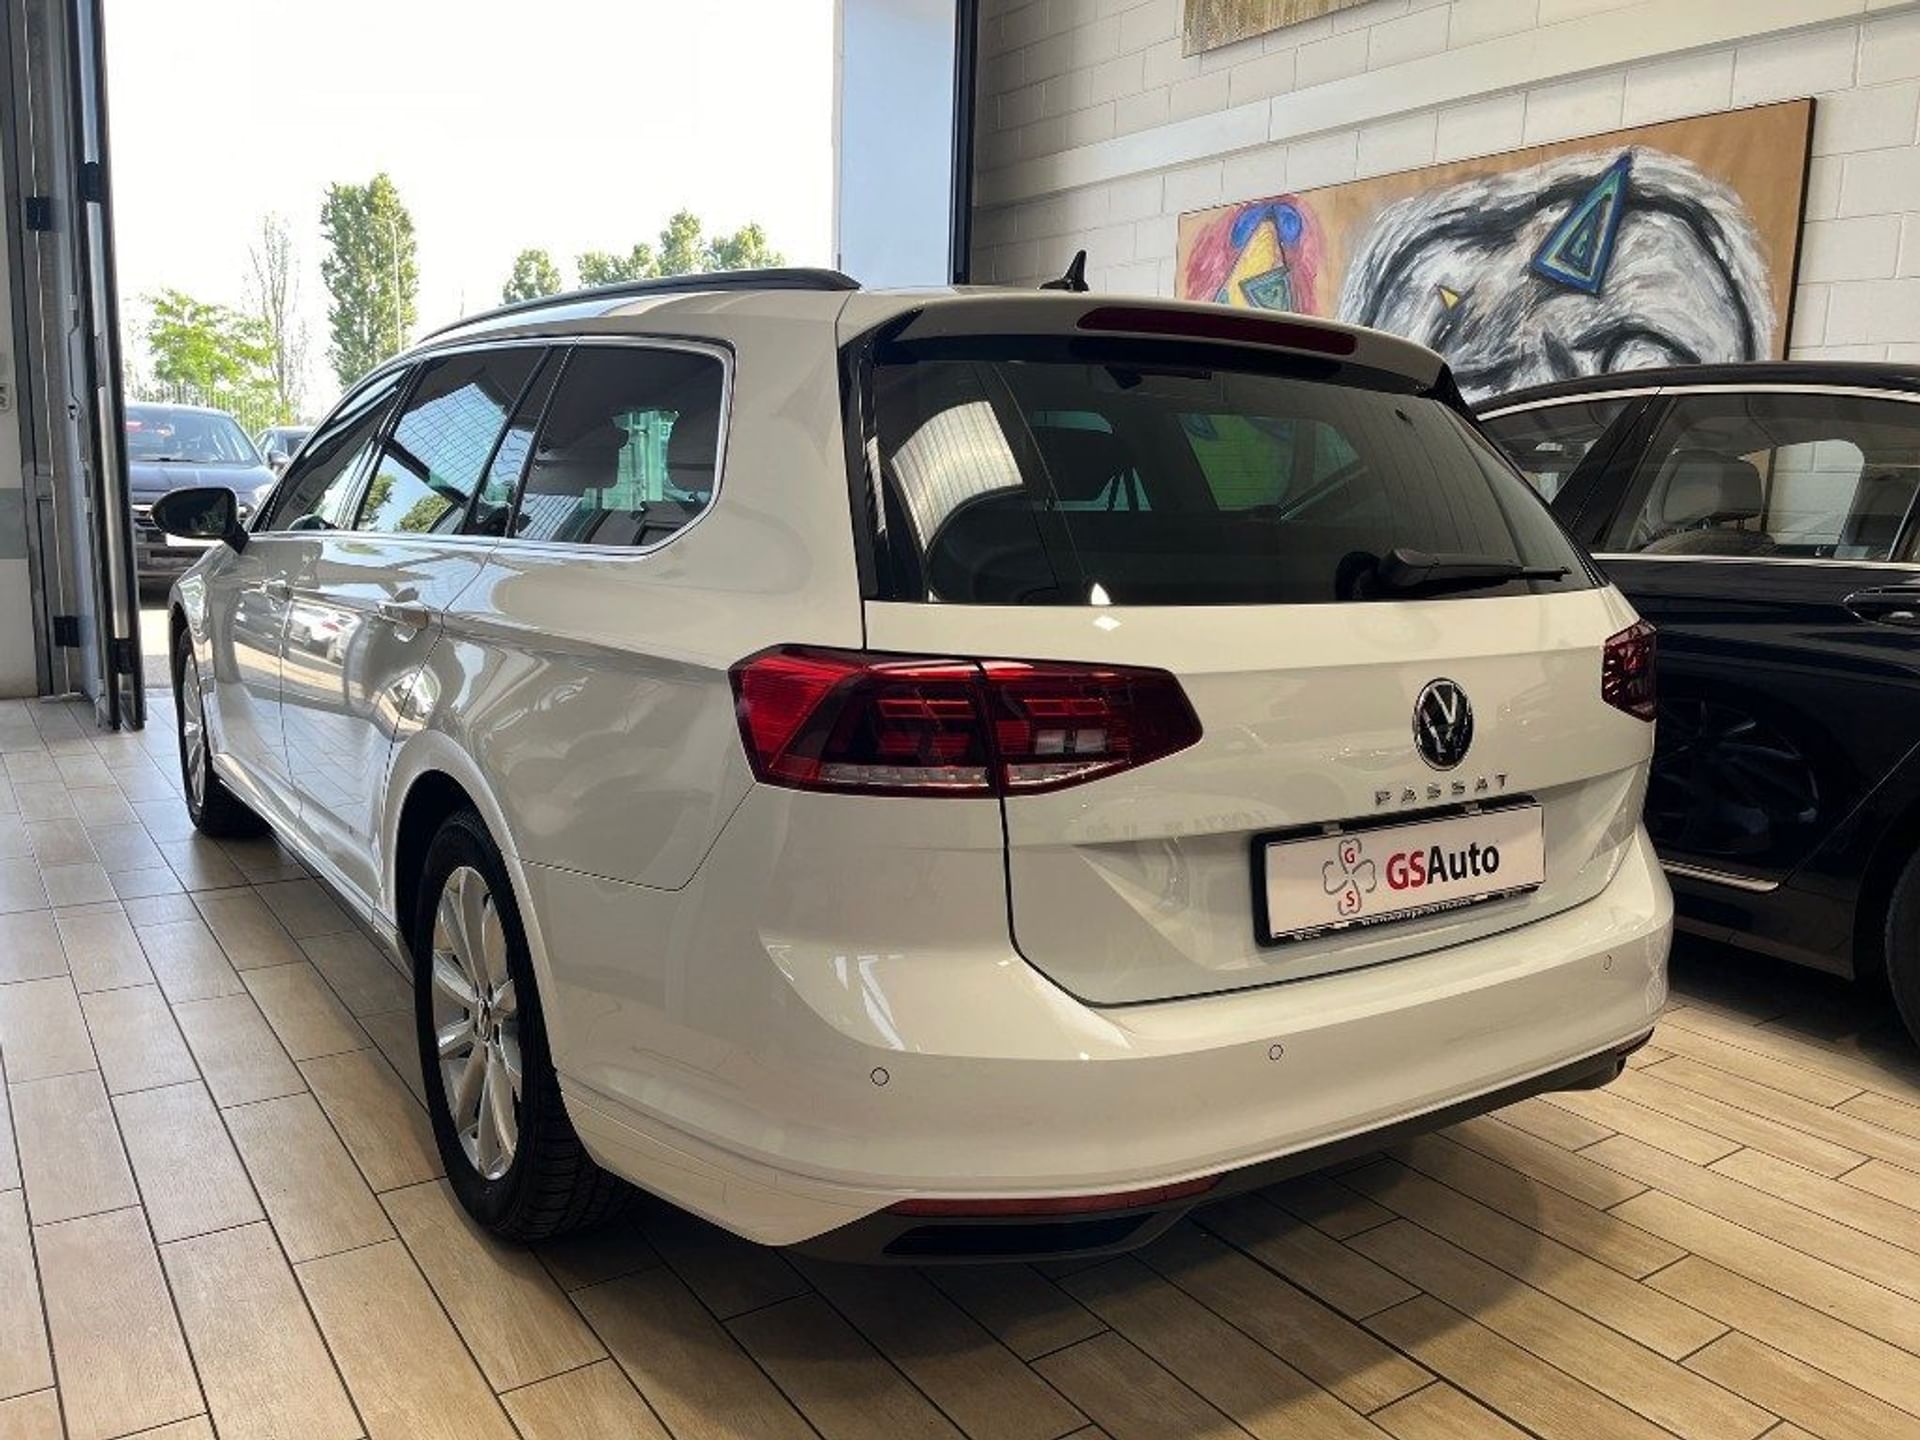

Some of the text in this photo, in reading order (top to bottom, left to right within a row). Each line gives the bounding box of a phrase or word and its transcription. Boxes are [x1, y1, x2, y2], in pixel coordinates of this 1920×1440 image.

[1374, 773, 1507, 806] PASSAT
[1344, 848, 1355, 864] G
[1386, 842, 1500, 890] GSAuto
[1346, 891, 1355, 907] S
